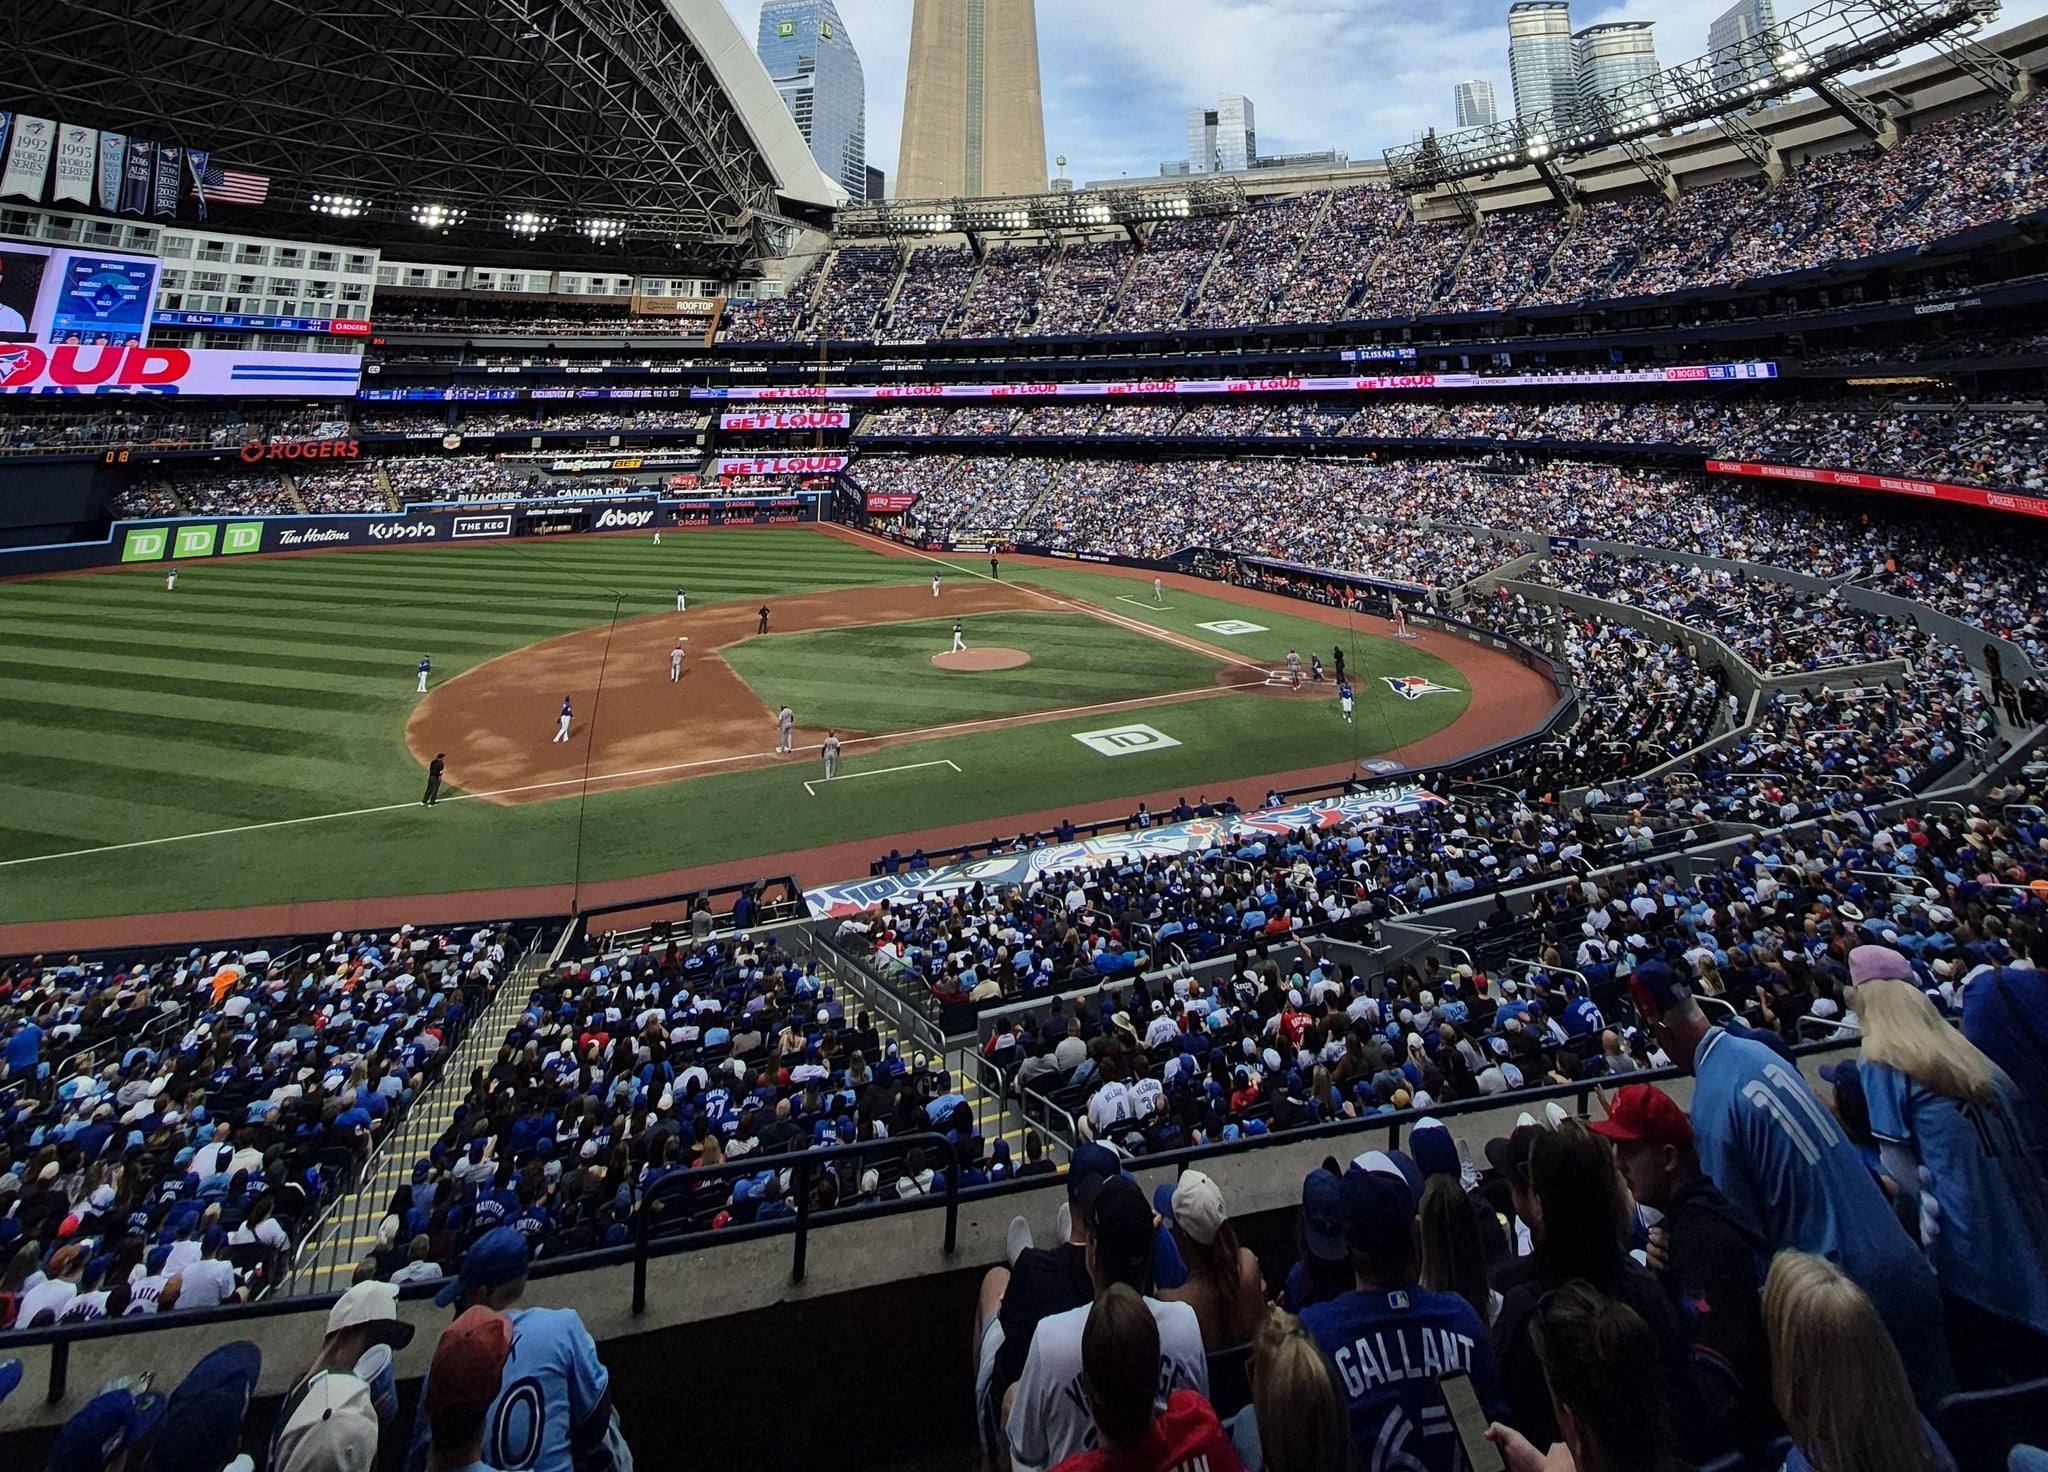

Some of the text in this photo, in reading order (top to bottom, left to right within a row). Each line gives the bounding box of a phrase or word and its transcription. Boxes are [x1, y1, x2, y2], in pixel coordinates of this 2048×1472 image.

[780, 24, 792, 33] TD
[16, 135, 48, 152] 1992
[14, 150, 45, 162] WORLD
[62, 144, 92, 158] 1993
[12, 159, 43, 171] SERIES
[60, 158, 92, 168] WORLD
[130, 156, 148, 166] 2016
[59, 166, 91, 176] SERIES
[159, 176, 177, 186] 2020
[676, 302, 714, 310] ROOFTOP
[1914, 302, 1956, 314] ticketmaster
[342, 324, 368, 332] ROGERS
[1677, 369, 1704, 378] ROGERS
[1137, 382, 1176, 392] LOUD
[1260, 379, 1300, 390] LOUD
[1356, 376, 1436, 389] GET LOUD
[758, 388, 827, 398] GET LOUD
[876, 386, 943, 397] GET LOUD
[1020, 384, 1057, 394] LOUD
[726, 413, 843, 429] GET LOUD
[269, 440, 359, 458] ROGERS
[553, 459, 610, 471] theScore
[723, 457, 842, 474] GET LOUD
[1724, 464, 1741, 472] ROGERS
[1840, 476, 1860, 484] ROGERS
[458, 492, 522, 502] BLEACHERS
[557, 487, 628, 497] CANADA DRY
[869, 498, 889, 506] HEINZ
[1993, 496, 2048, 514] ROGERS TERRACE
[596, 508, 654, 528] Sobeys
[368, 522, 436, 538] Kubota
[484, 522, 504, 530] KEG
[180, 532, 212, 551] TD
[229, 528, 258, 548] TD
[279, 527, 350, 545] Tim Hortons
[130, 535, 161, 555] TD
[1088, 731, 1159, 748] TD
[705, 1101, 725, 1120] 27
[1116, 1102, 1125, 1121] 4
[476, 1200, 504, 1216] BAUTISTA
[1335, 1327, 1474, 1398] GALLANT
[491, 1376, 545, 1471] 0
